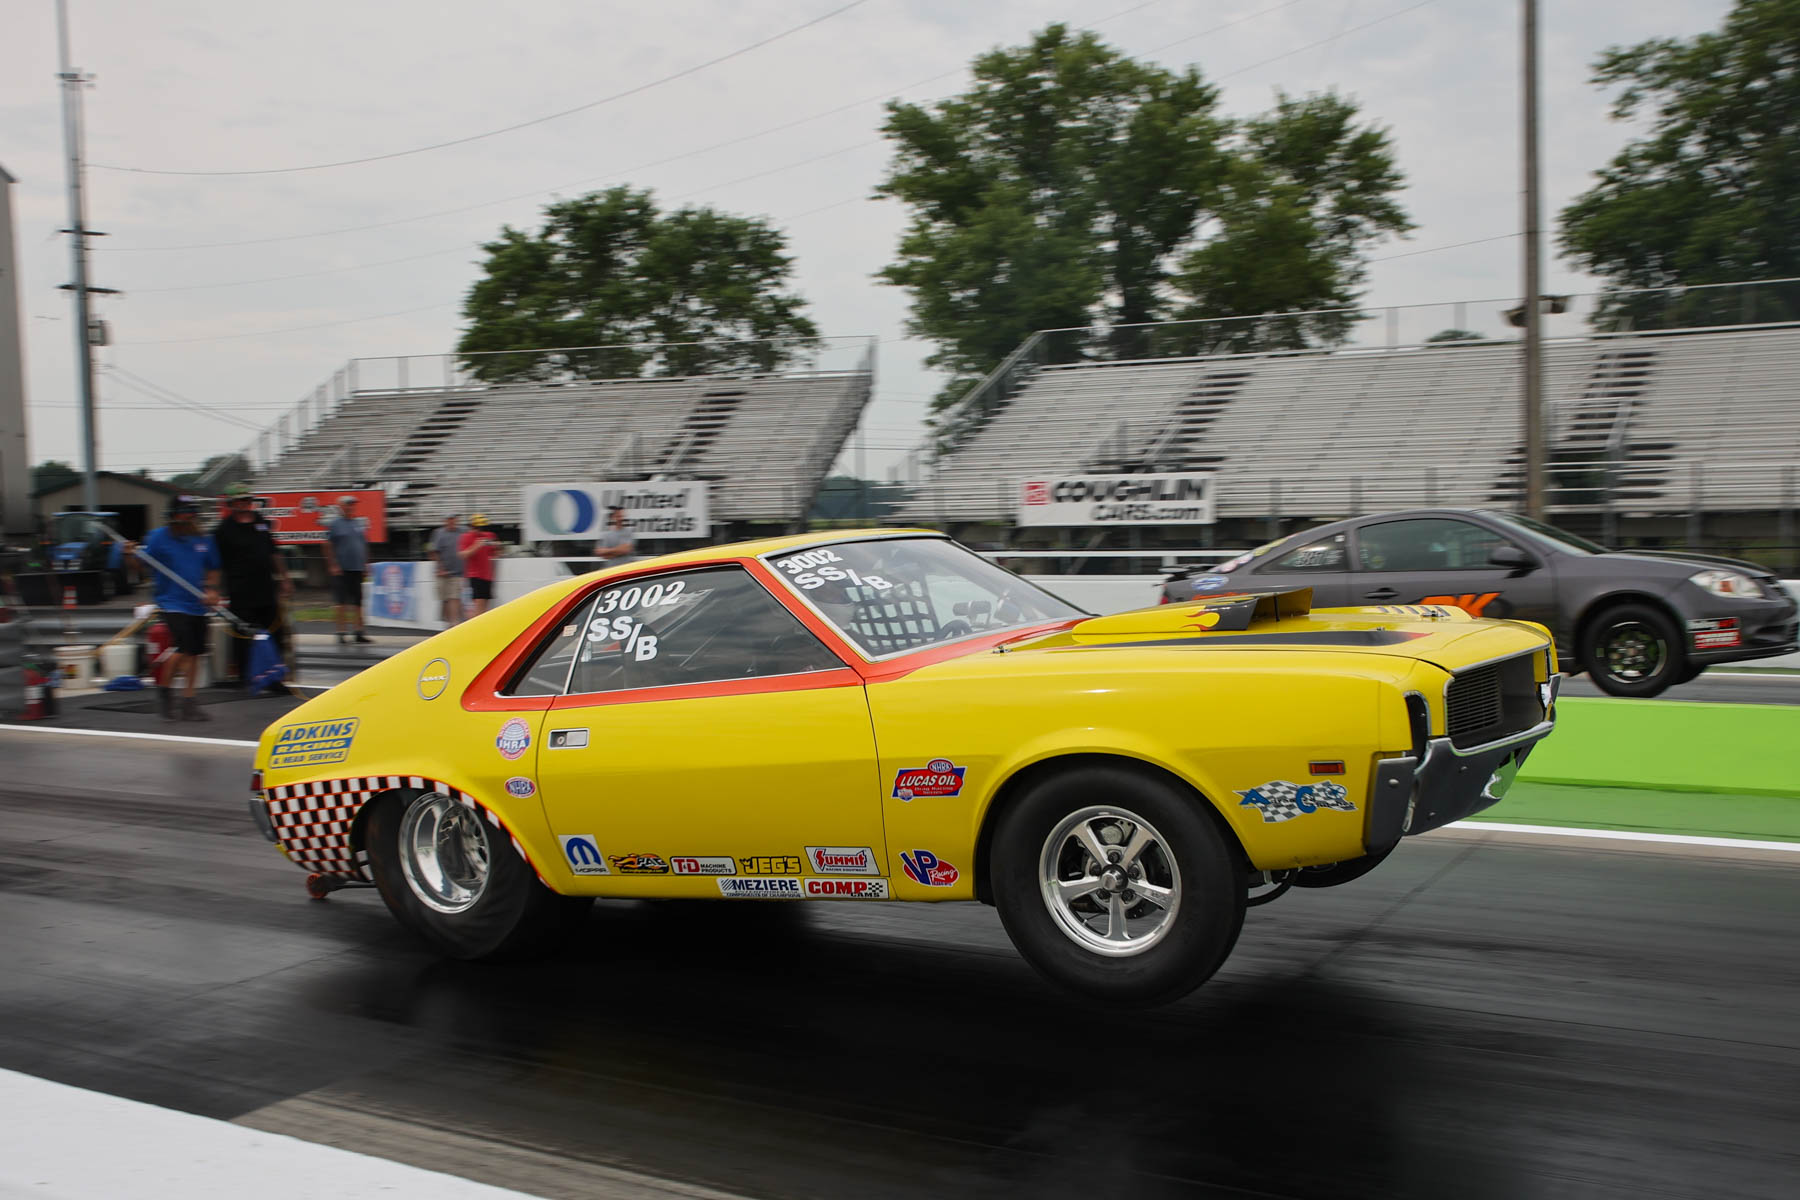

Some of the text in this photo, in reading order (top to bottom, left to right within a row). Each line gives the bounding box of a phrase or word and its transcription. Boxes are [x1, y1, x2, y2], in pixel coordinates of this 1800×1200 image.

[602, 488, 690, 509] United
[1055, 479, 1204, 503] COUGHLIN
[777, 549, 843, 574] 3002
[794, 566, 893, 590] SS/B
[597, 581, 685, 613] 3002
[587, 616, 657, 661] SS/B
[280, 722, 354, 742] ADKINS
[276, 740, 346, 754] RACING
[500, 740, 526, 750] IHRA
[900, 775, 956, 787] LUCAS OIL
[744, 856, 801, 874] JEG'S
[900, 849, 938, 886] VP
[732, 879, 799, 891] MEZIERE
[930, 869, 957, 882] Racing
[808, 881, 868, 894] COMP
